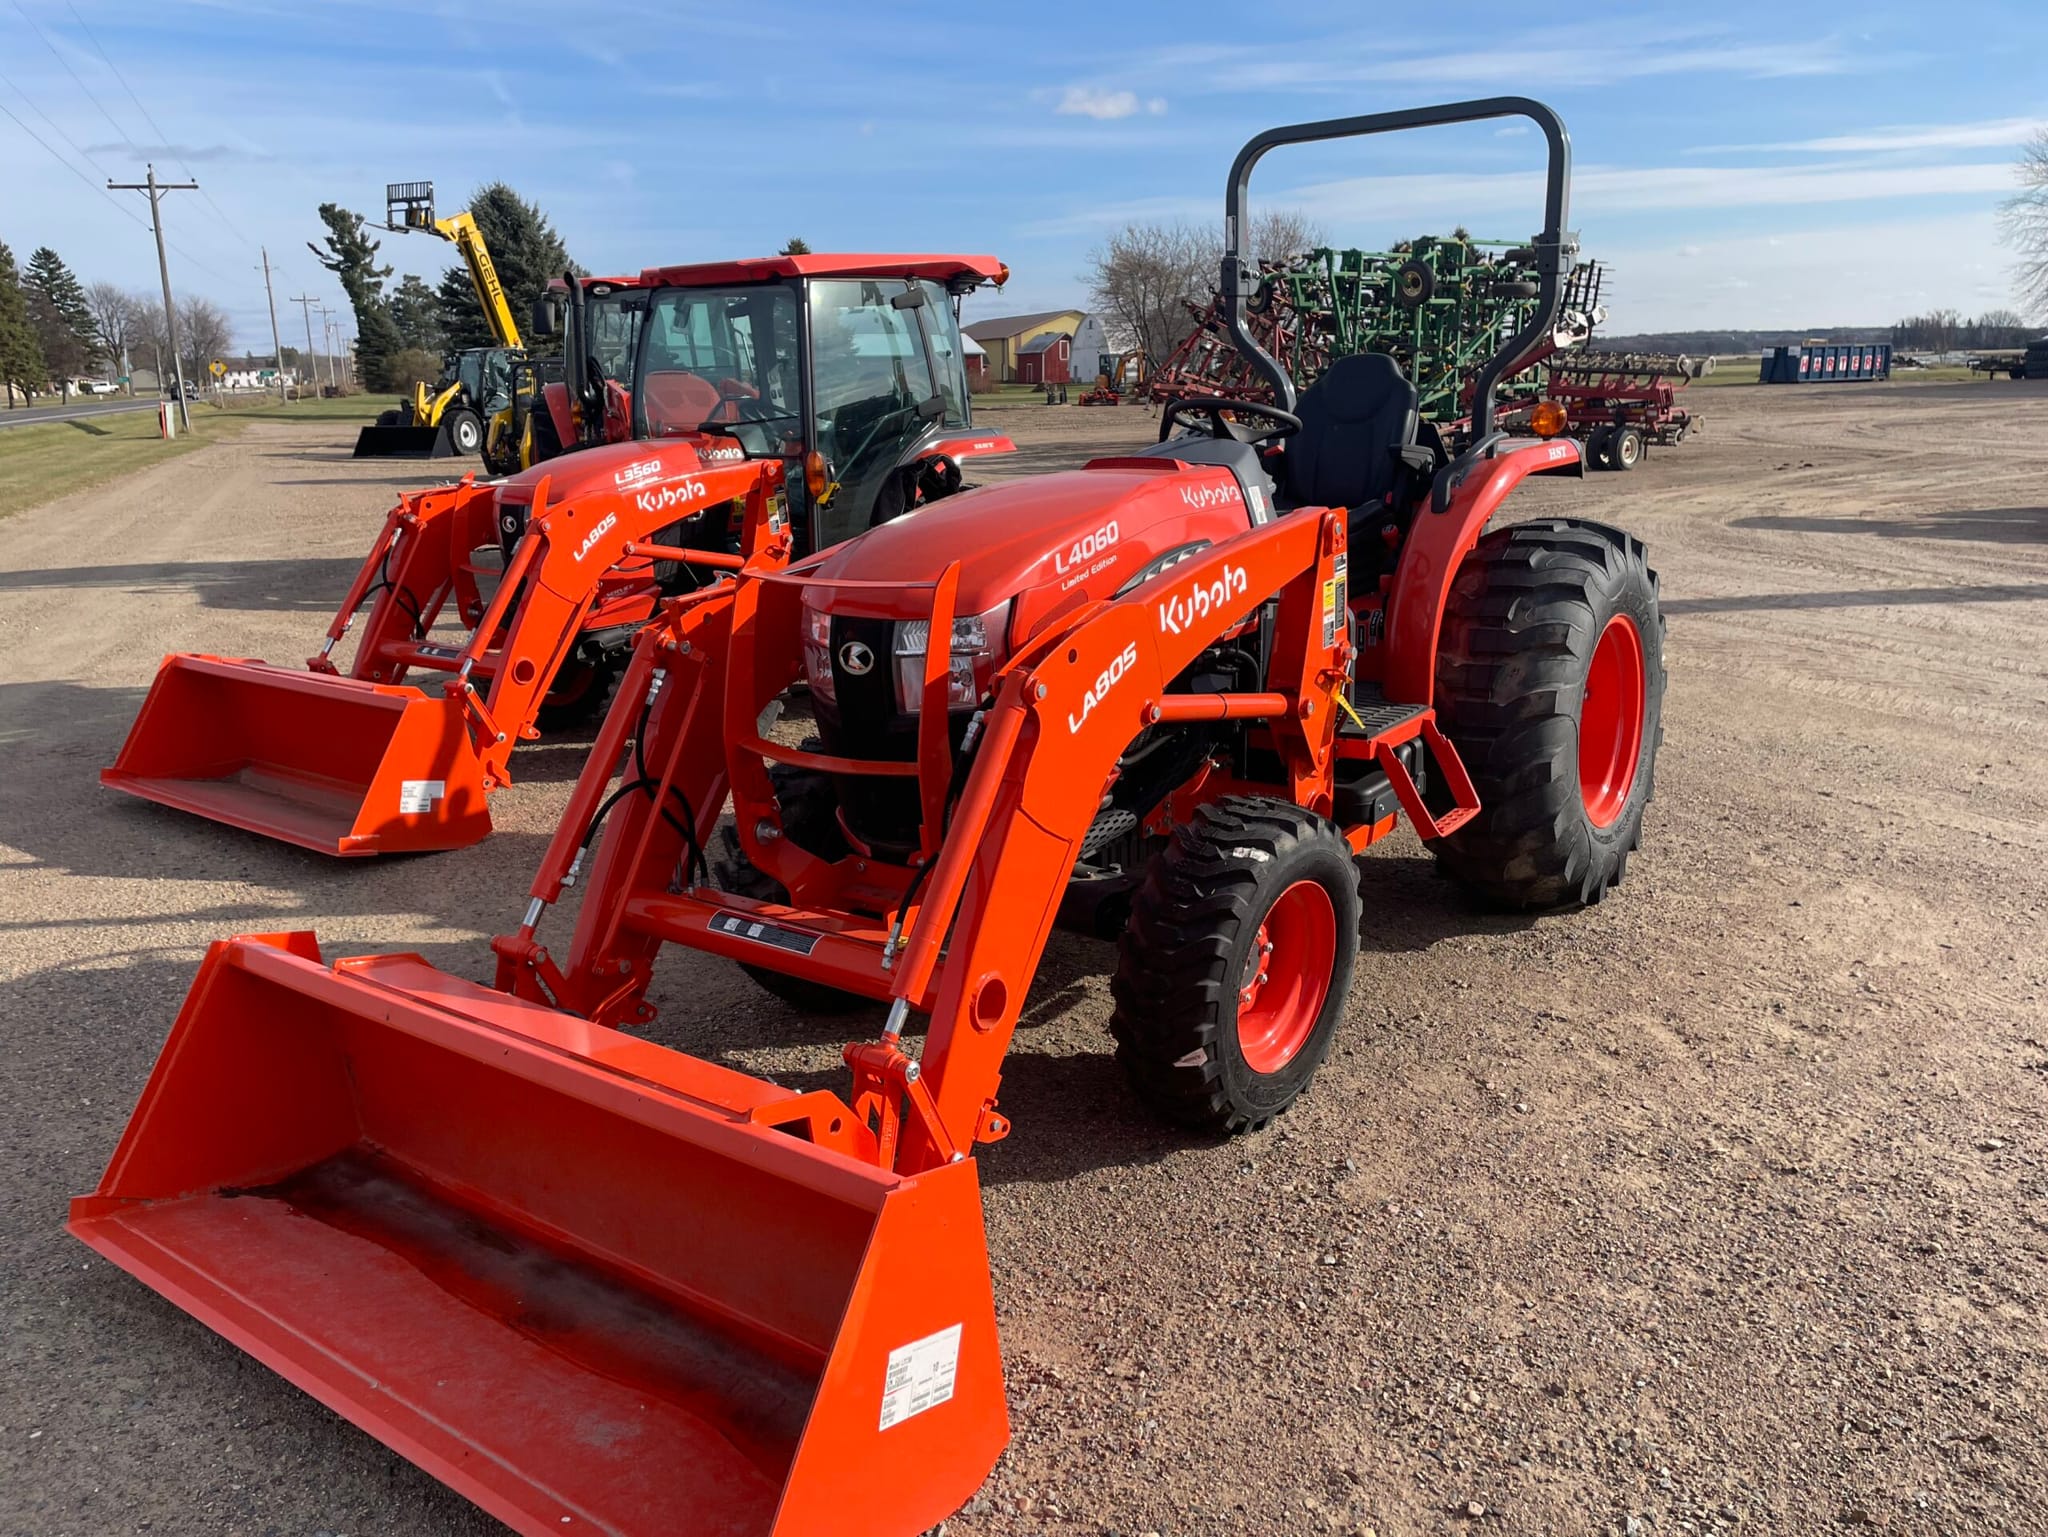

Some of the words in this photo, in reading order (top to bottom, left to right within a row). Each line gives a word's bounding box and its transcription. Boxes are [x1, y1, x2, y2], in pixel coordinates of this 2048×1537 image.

[479, 254, 501, 305] GEHL
[1799, 355, 1882, 373] HARTERS
[1548, 446, 1566, 461] HST
[615, 460, 661, 485] L3560
[637, 480, 706, 512] Kubota
[1180, 481, 1242, 508] Kubota
[573, 512, 617, 561] LA805
[1055, 520, 1119, 574] L4060
[1061, 569, 1090, 591] Limited
[1091, 555, 1117, 574] Edition
[1159, 564, 1247, 634] Kubota
[1068, 641, 1137, 734] LA805
